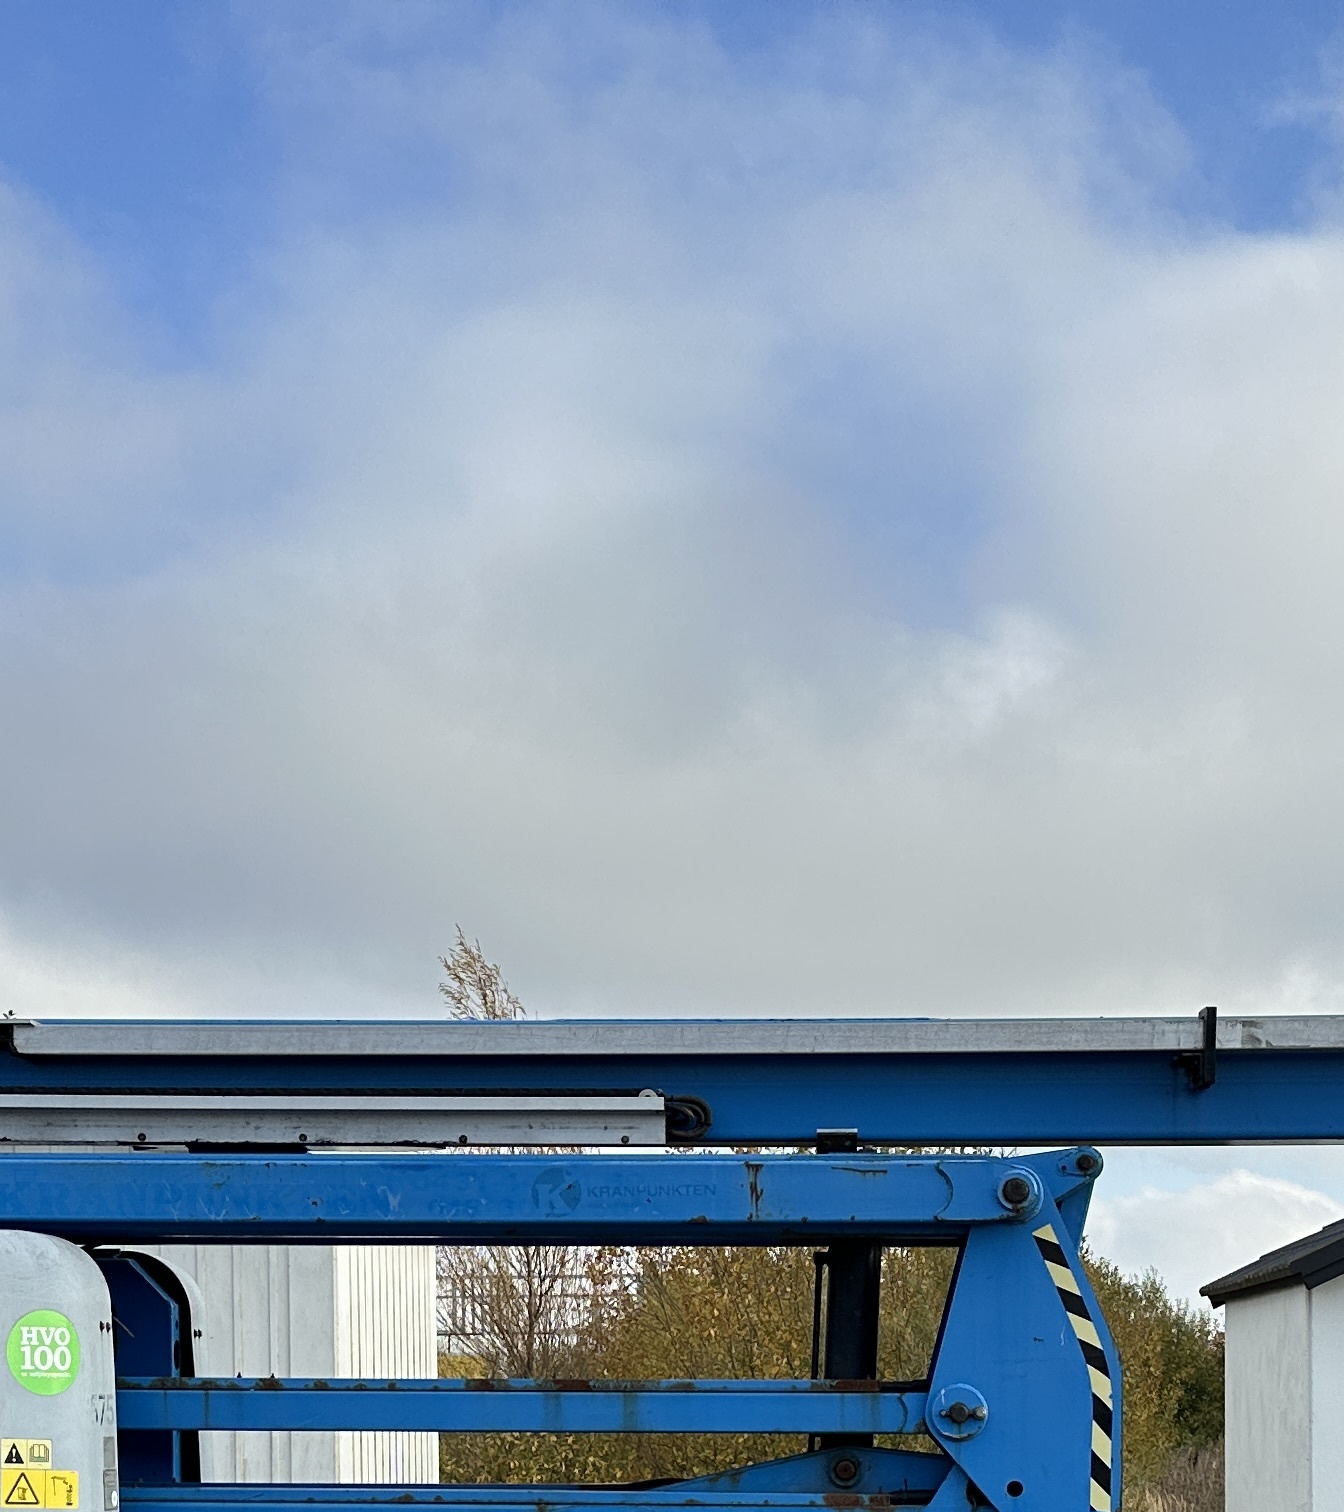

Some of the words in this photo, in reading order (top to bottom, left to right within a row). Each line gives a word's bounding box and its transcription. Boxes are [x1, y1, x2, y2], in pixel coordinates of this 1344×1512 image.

[587, 1183, 717, 1199] KRANPUNKTEN
[19, 1326, 71, 1346] HVO
[20, 1345, 72, 1371] 100
